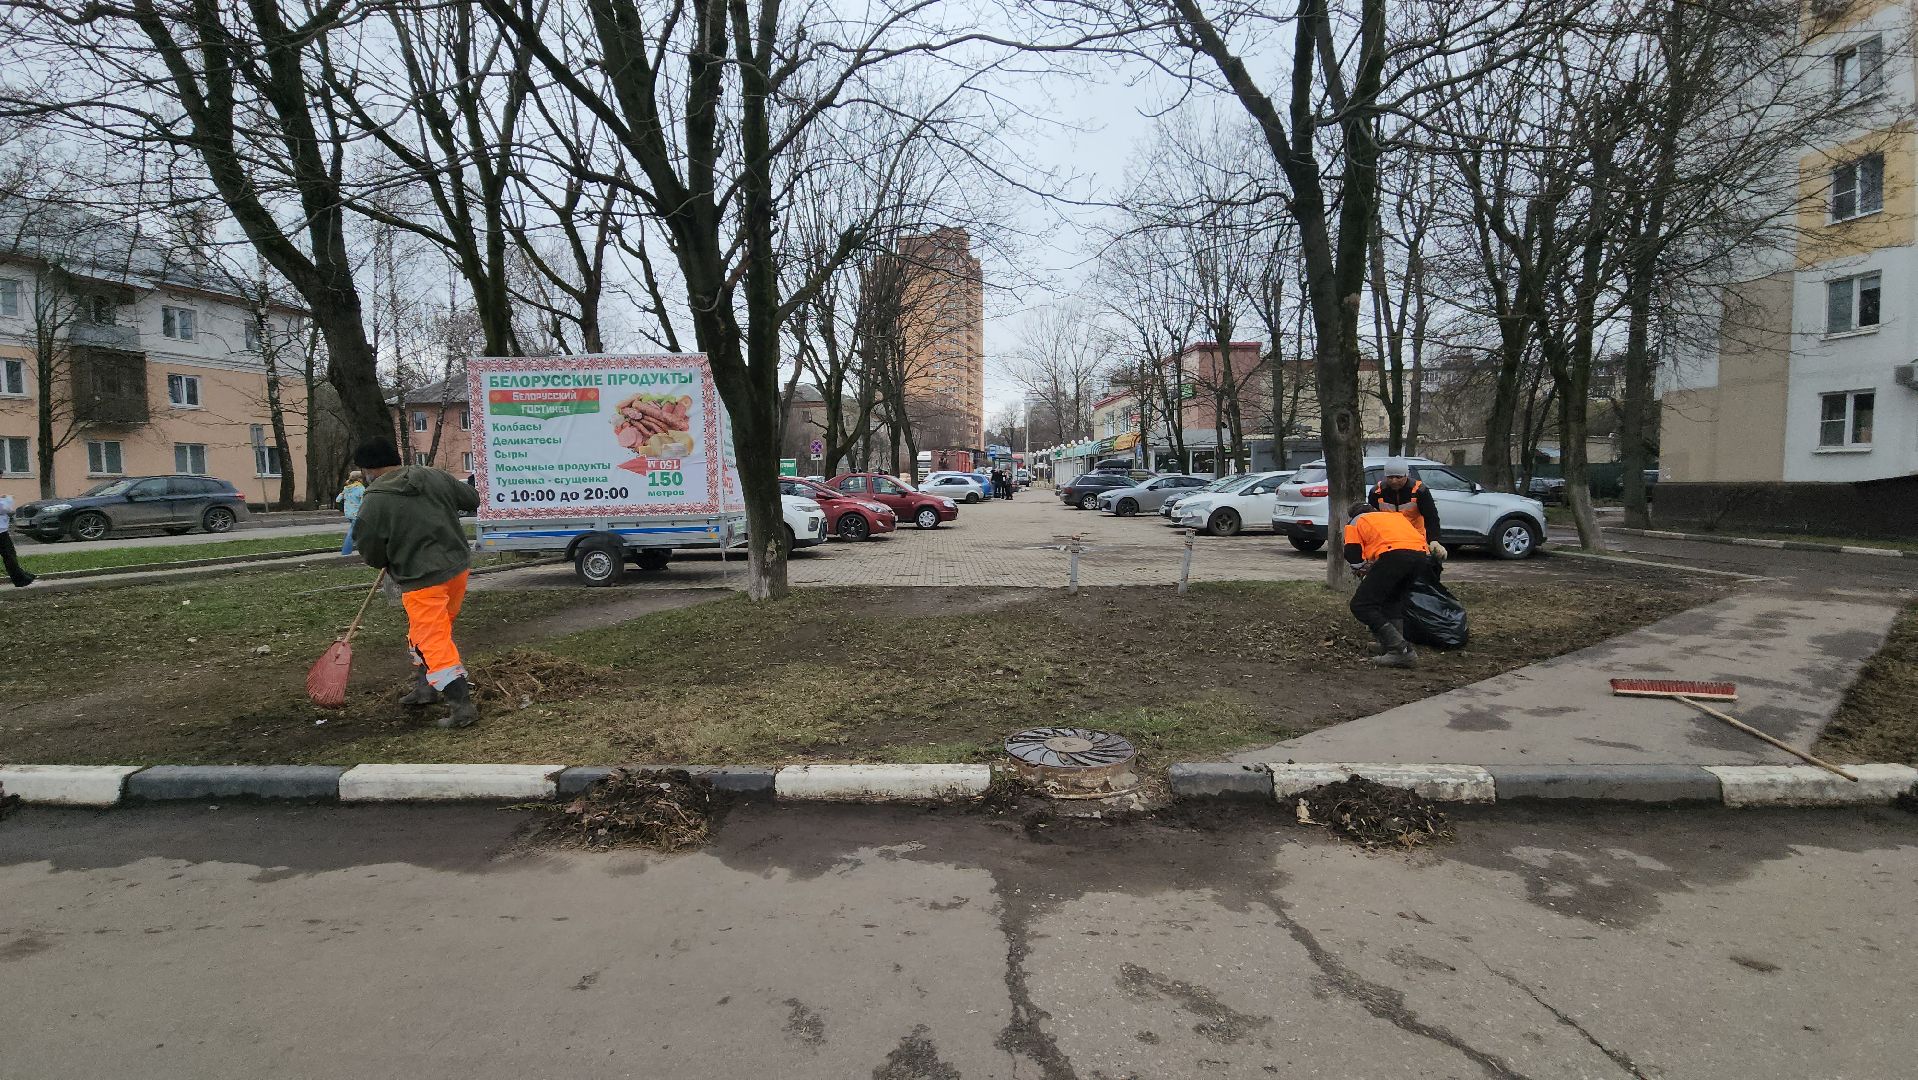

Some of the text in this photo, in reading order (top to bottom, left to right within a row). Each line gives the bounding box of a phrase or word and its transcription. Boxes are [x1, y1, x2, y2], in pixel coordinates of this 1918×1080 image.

[489, 372, 693, 388] БЕЛОРУССКИЕ ПРОДУКТЫ
[492, 422, 542, 432] Колбасы
[492, 437, 562, 446] Деликатесы
[494, 450, 528, 459] Сыры
[495, 462, 611, 472] Молочные продукты
[496, 477, 545, 487] Тушенка
[554, 476, 608, 486] сгущенка
[648, 472, 683, 486] 150
[496, 487, 629, 503] с 10:00 до 20:00
